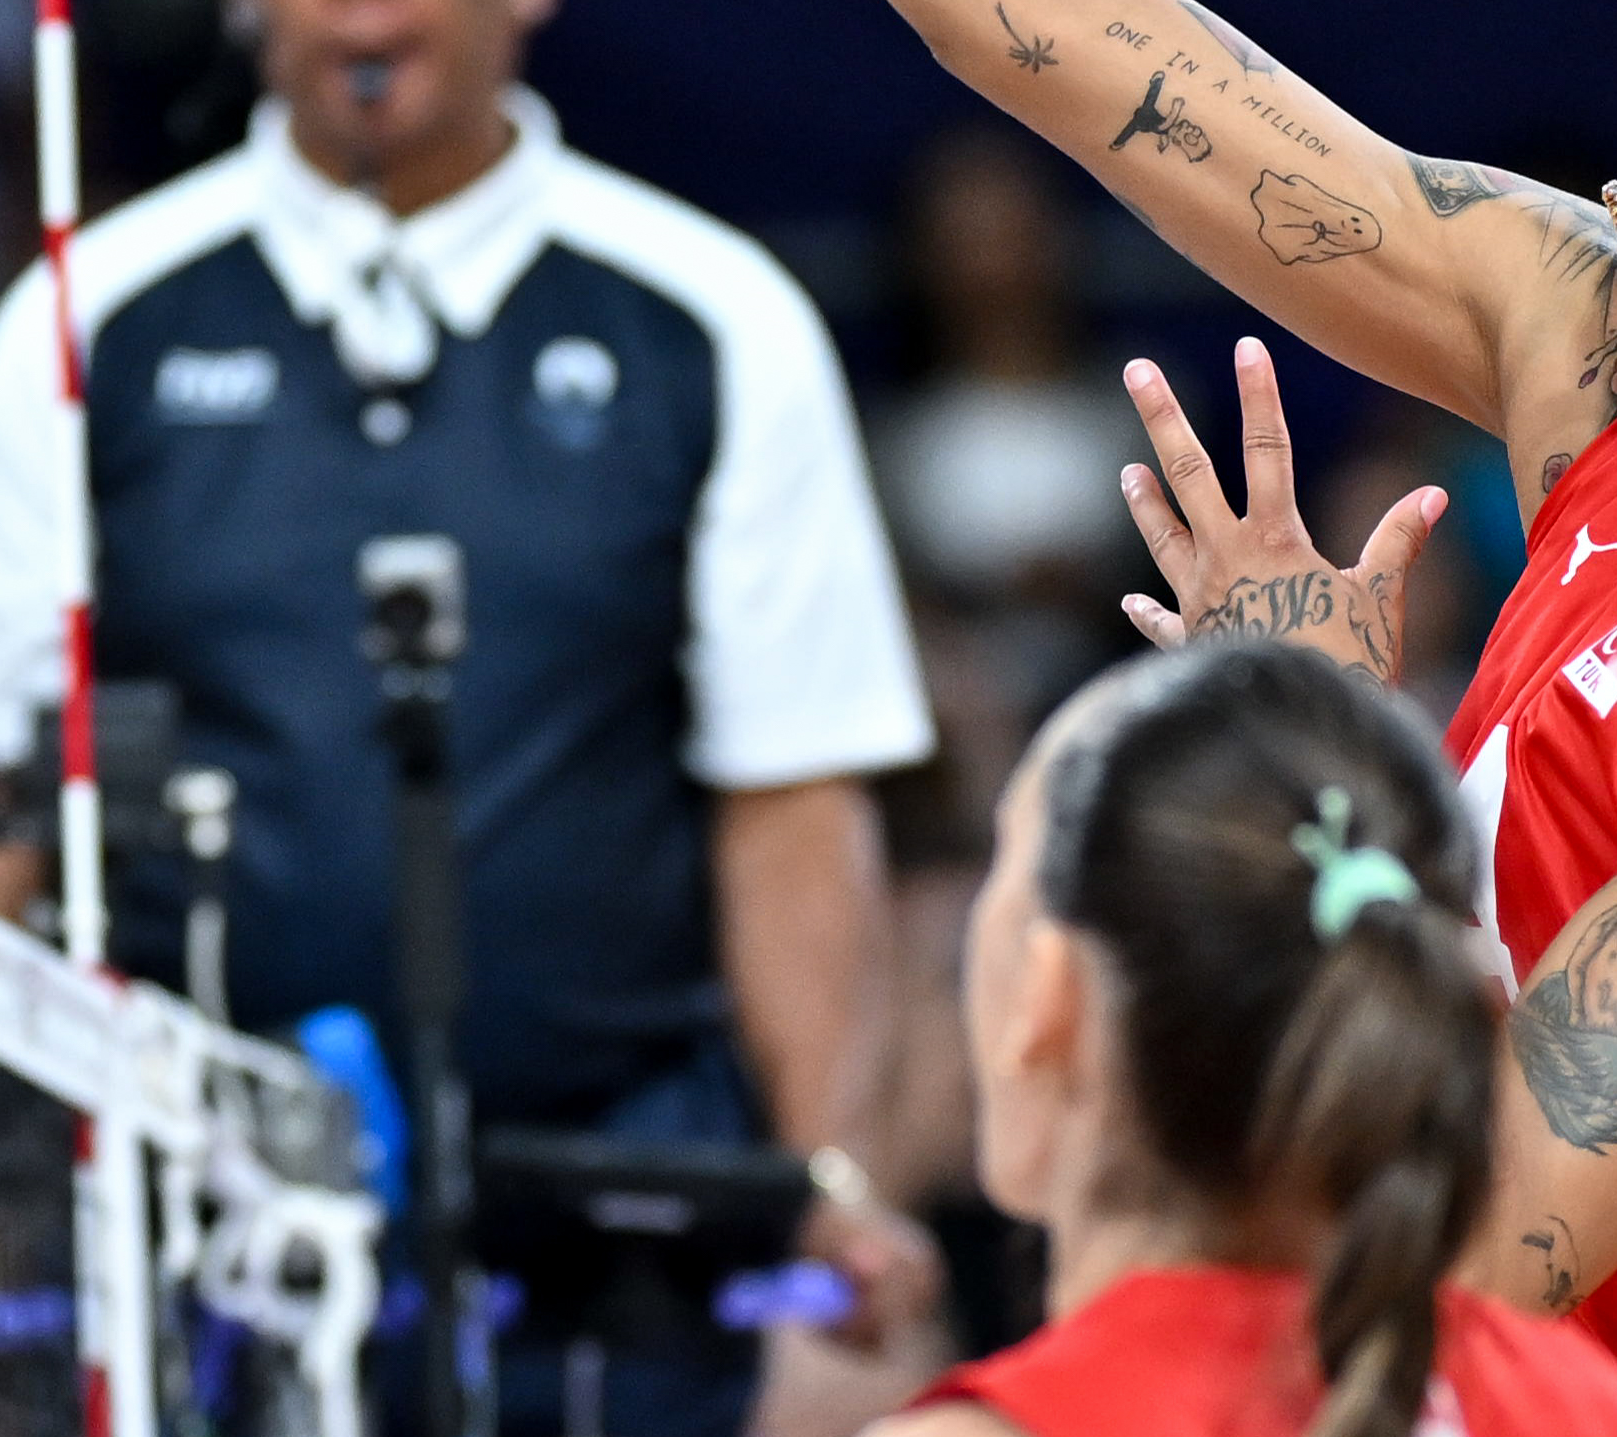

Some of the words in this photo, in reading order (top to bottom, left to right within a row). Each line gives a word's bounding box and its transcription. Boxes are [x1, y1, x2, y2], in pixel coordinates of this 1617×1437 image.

[1106, 21, 1153, 51] ONE
[1167, 51, 1200, 75] IN
[1213, 79, 1229, 94] A
[1241, 95, 1333, 157] MILLION
